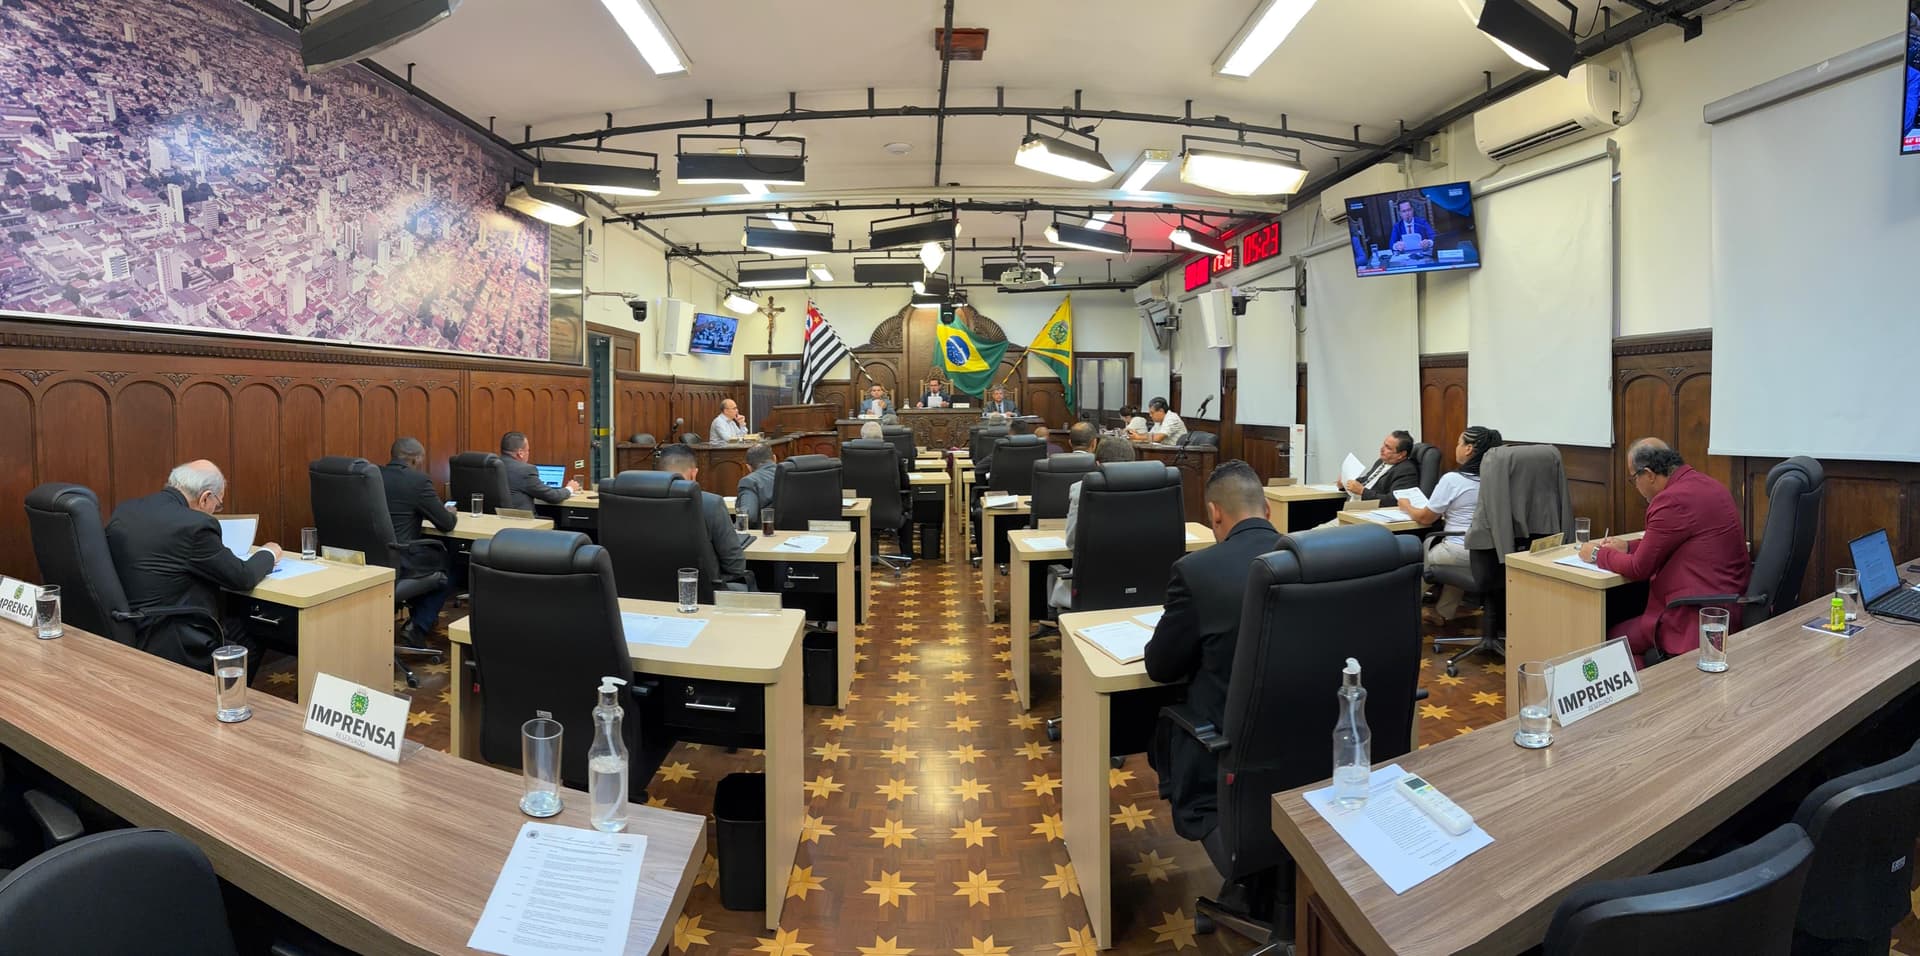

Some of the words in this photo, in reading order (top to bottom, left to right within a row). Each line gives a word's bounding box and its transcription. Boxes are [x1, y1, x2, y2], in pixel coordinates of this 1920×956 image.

[1243, 223, 1279, 266] 05:23
[1558, 671, 1633, 714] IMPRENSA
[311, 704, 395, 750] IMPRENSA
